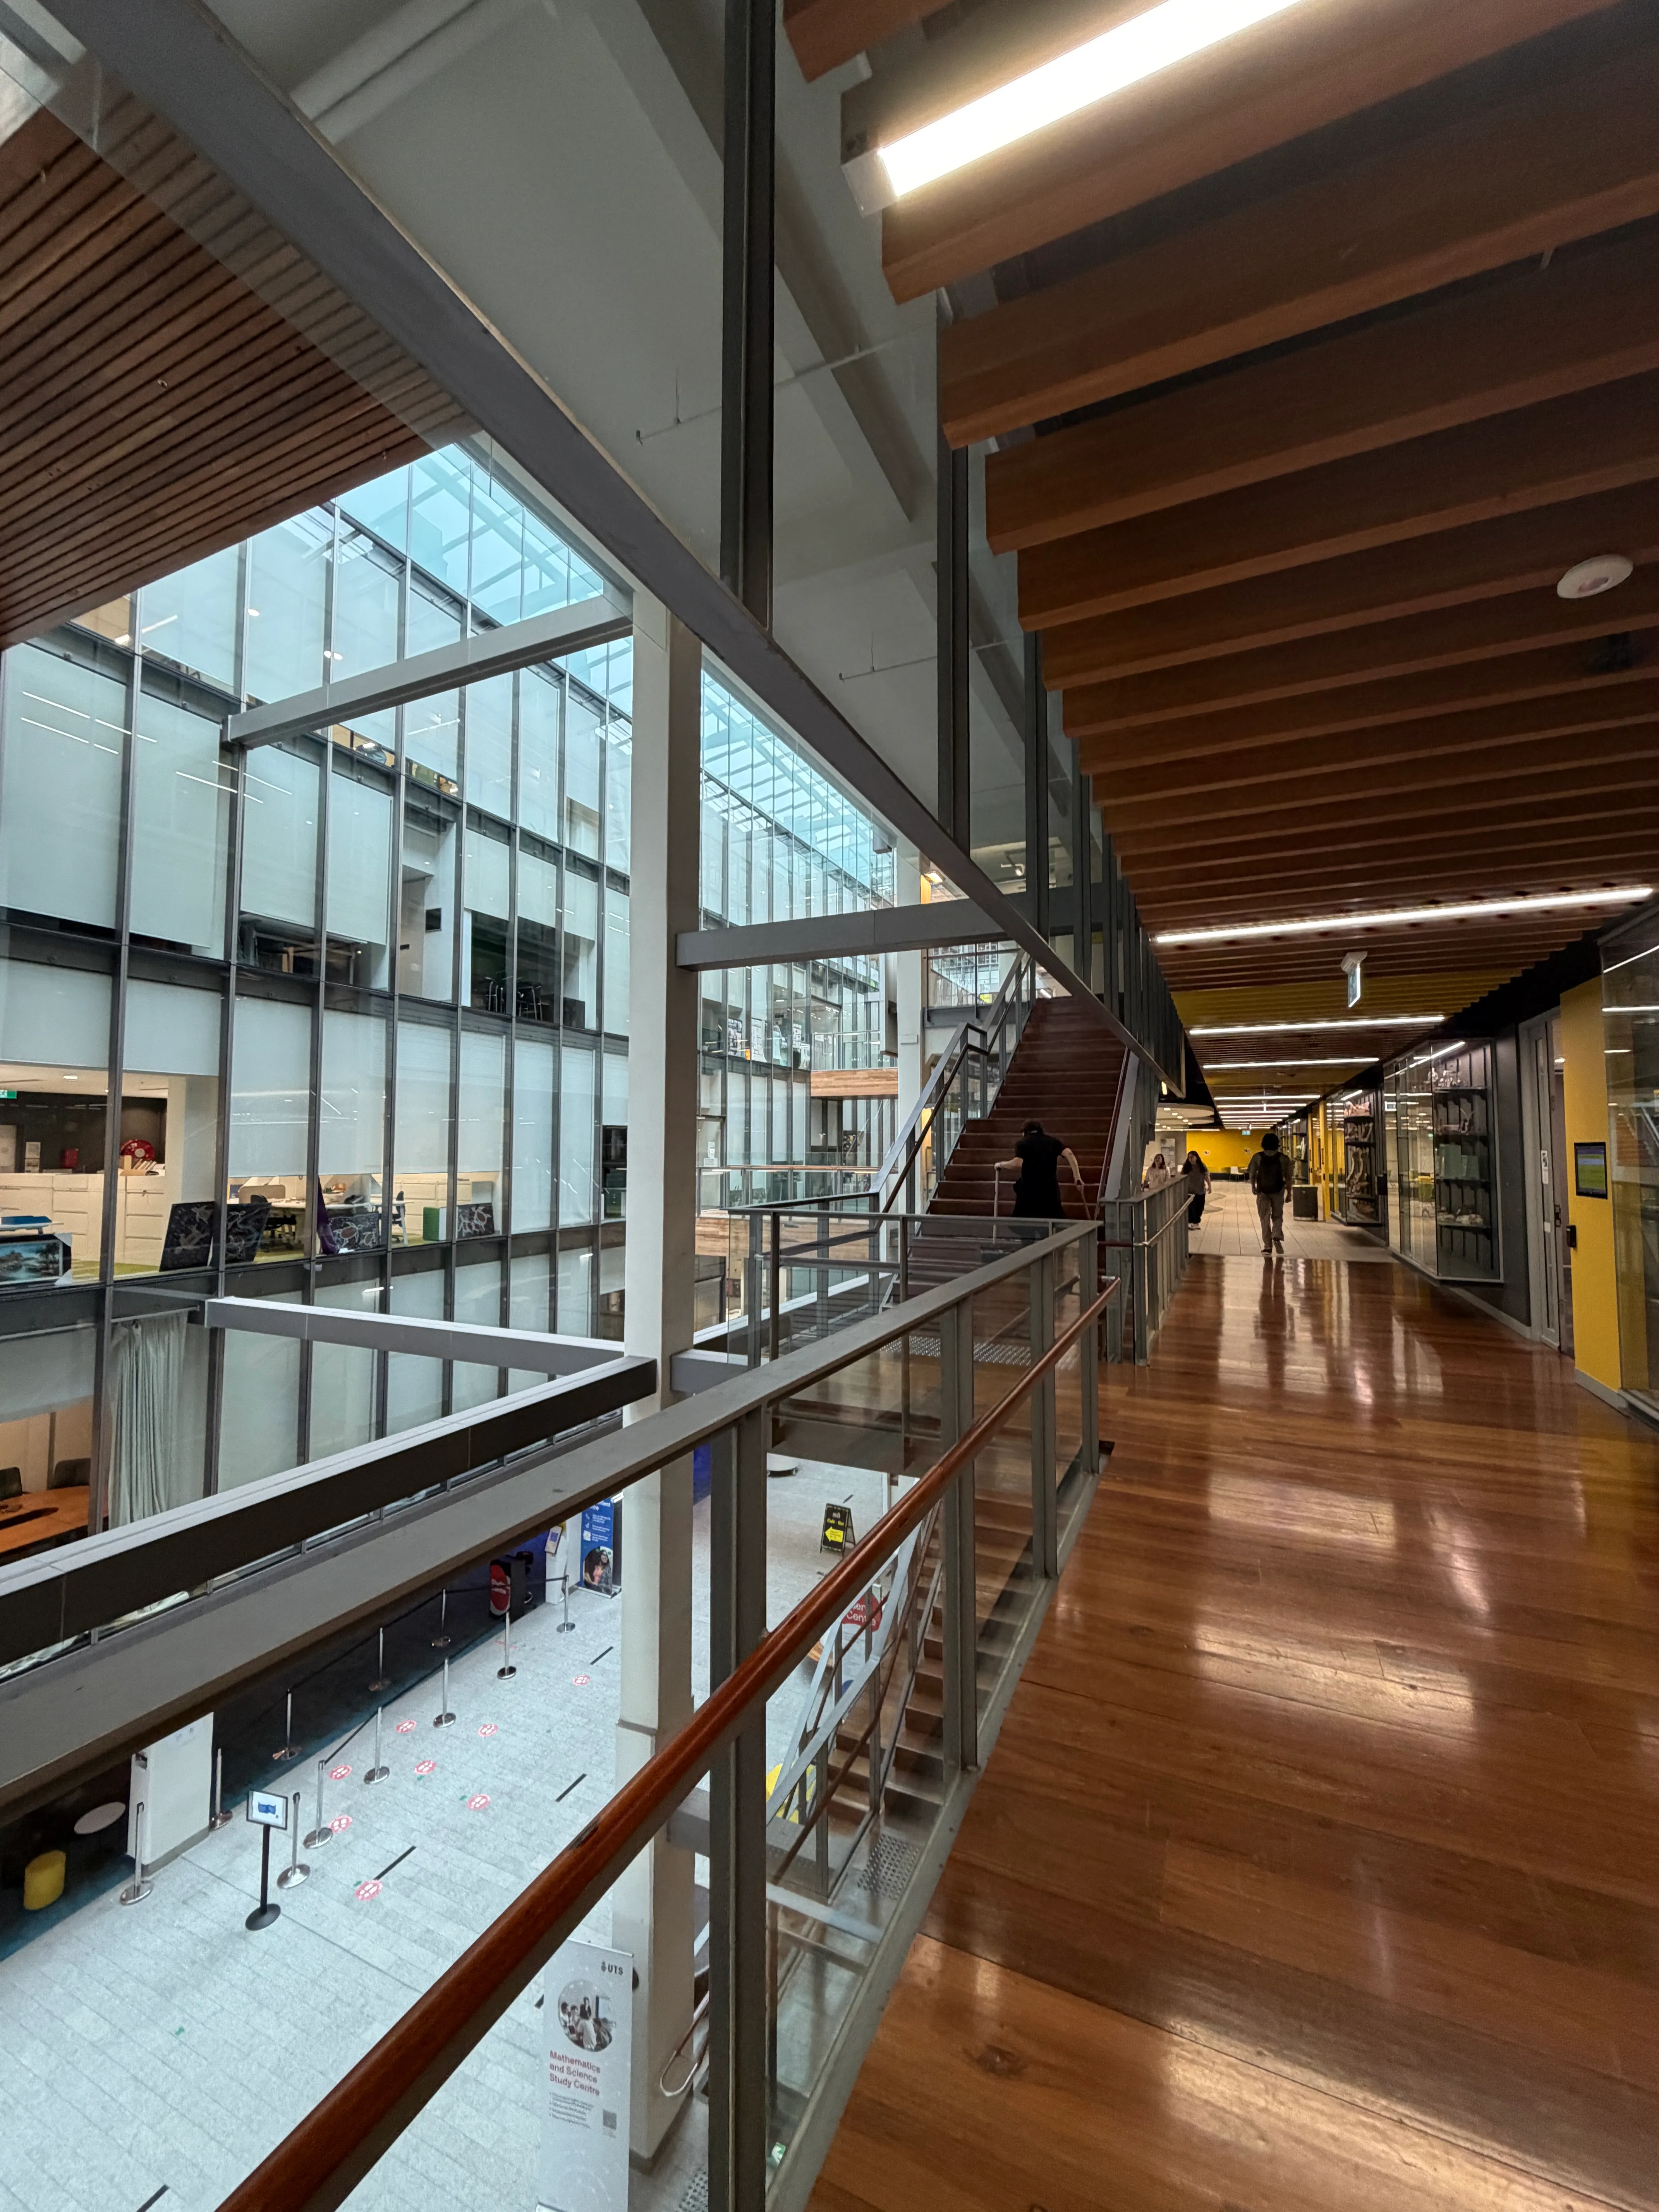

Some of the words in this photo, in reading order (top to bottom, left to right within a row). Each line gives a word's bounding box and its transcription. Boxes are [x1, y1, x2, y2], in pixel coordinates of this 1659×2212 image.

[608, 1964, 623, 1975] UTS
[550, 2050, 601, 2073] Mathematics
[550, 2063, 564, 2074] and
[566, 2066, 597, 2083] Science
[550, 2073, 572, 2088] Study
[574, 2080, 600, 2096] Centre
